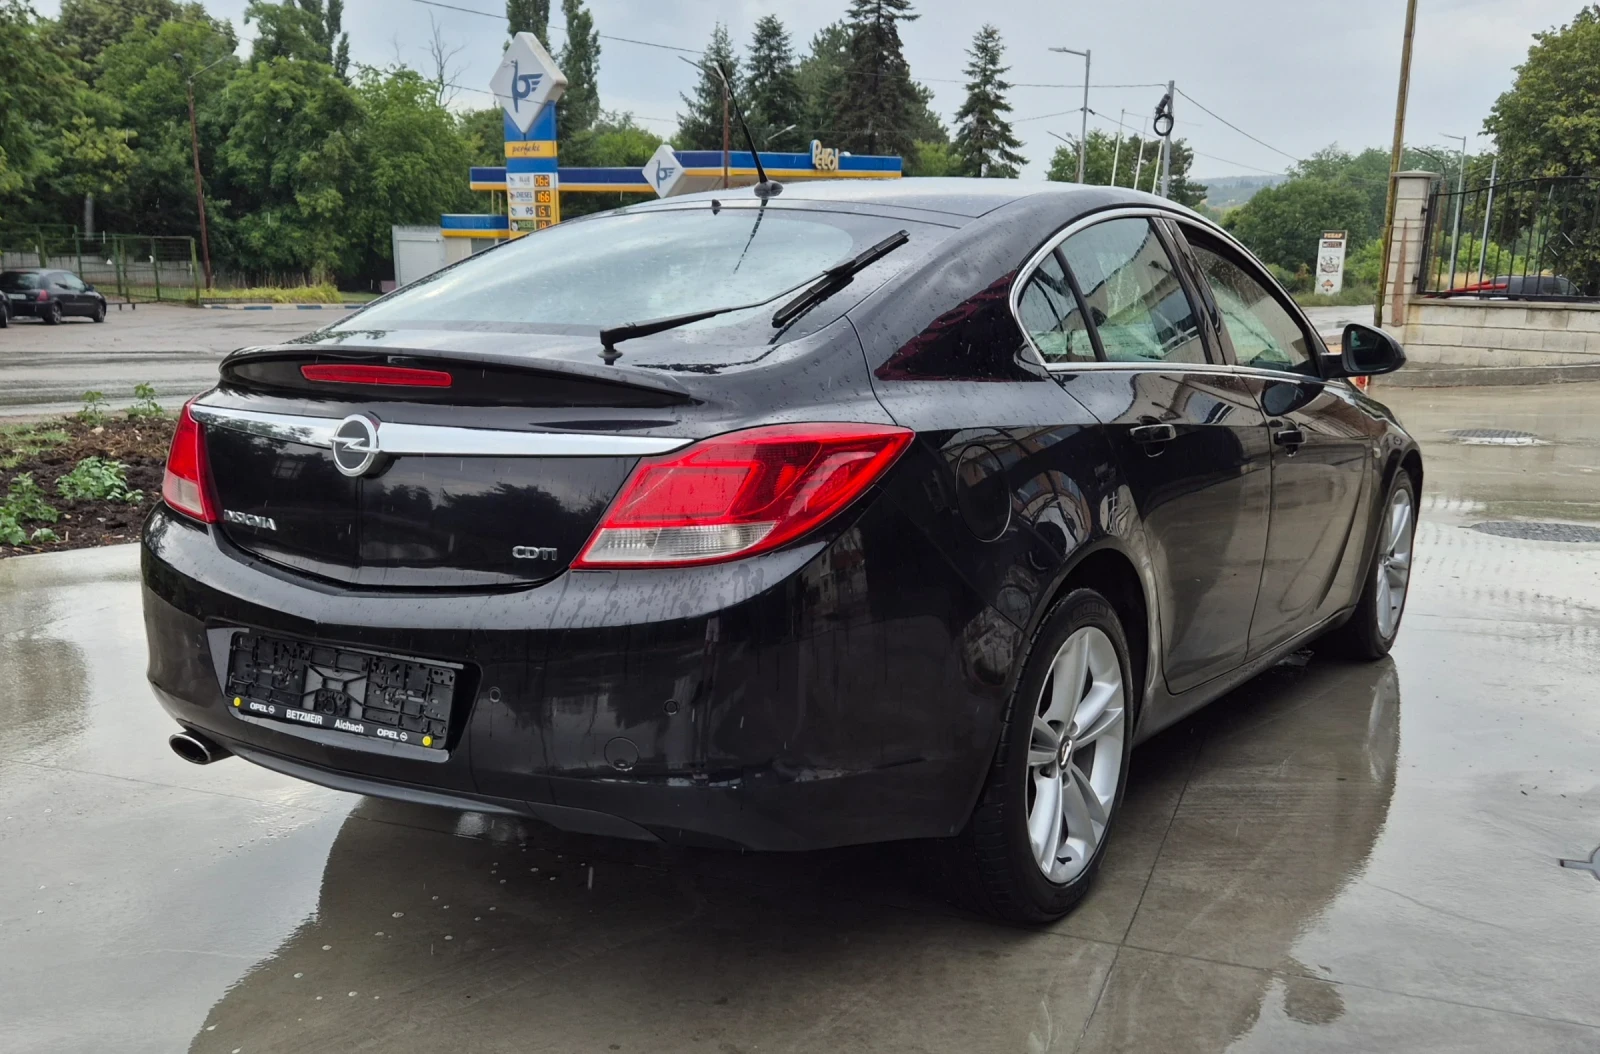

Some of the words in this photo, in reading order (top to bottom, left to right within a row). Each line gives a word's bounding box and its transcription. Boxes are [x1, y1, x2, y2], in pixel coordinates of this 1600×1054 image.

[810, 139, 839, 170] Petrol
[525, 206, 534, 215] 95
[249, 702, 268, 713] OPEL
[285, 709, 323, 725] BETZMEIR
[334, 719, 364, 733] Aichach
[376, 728, 399, 740] OPEL
